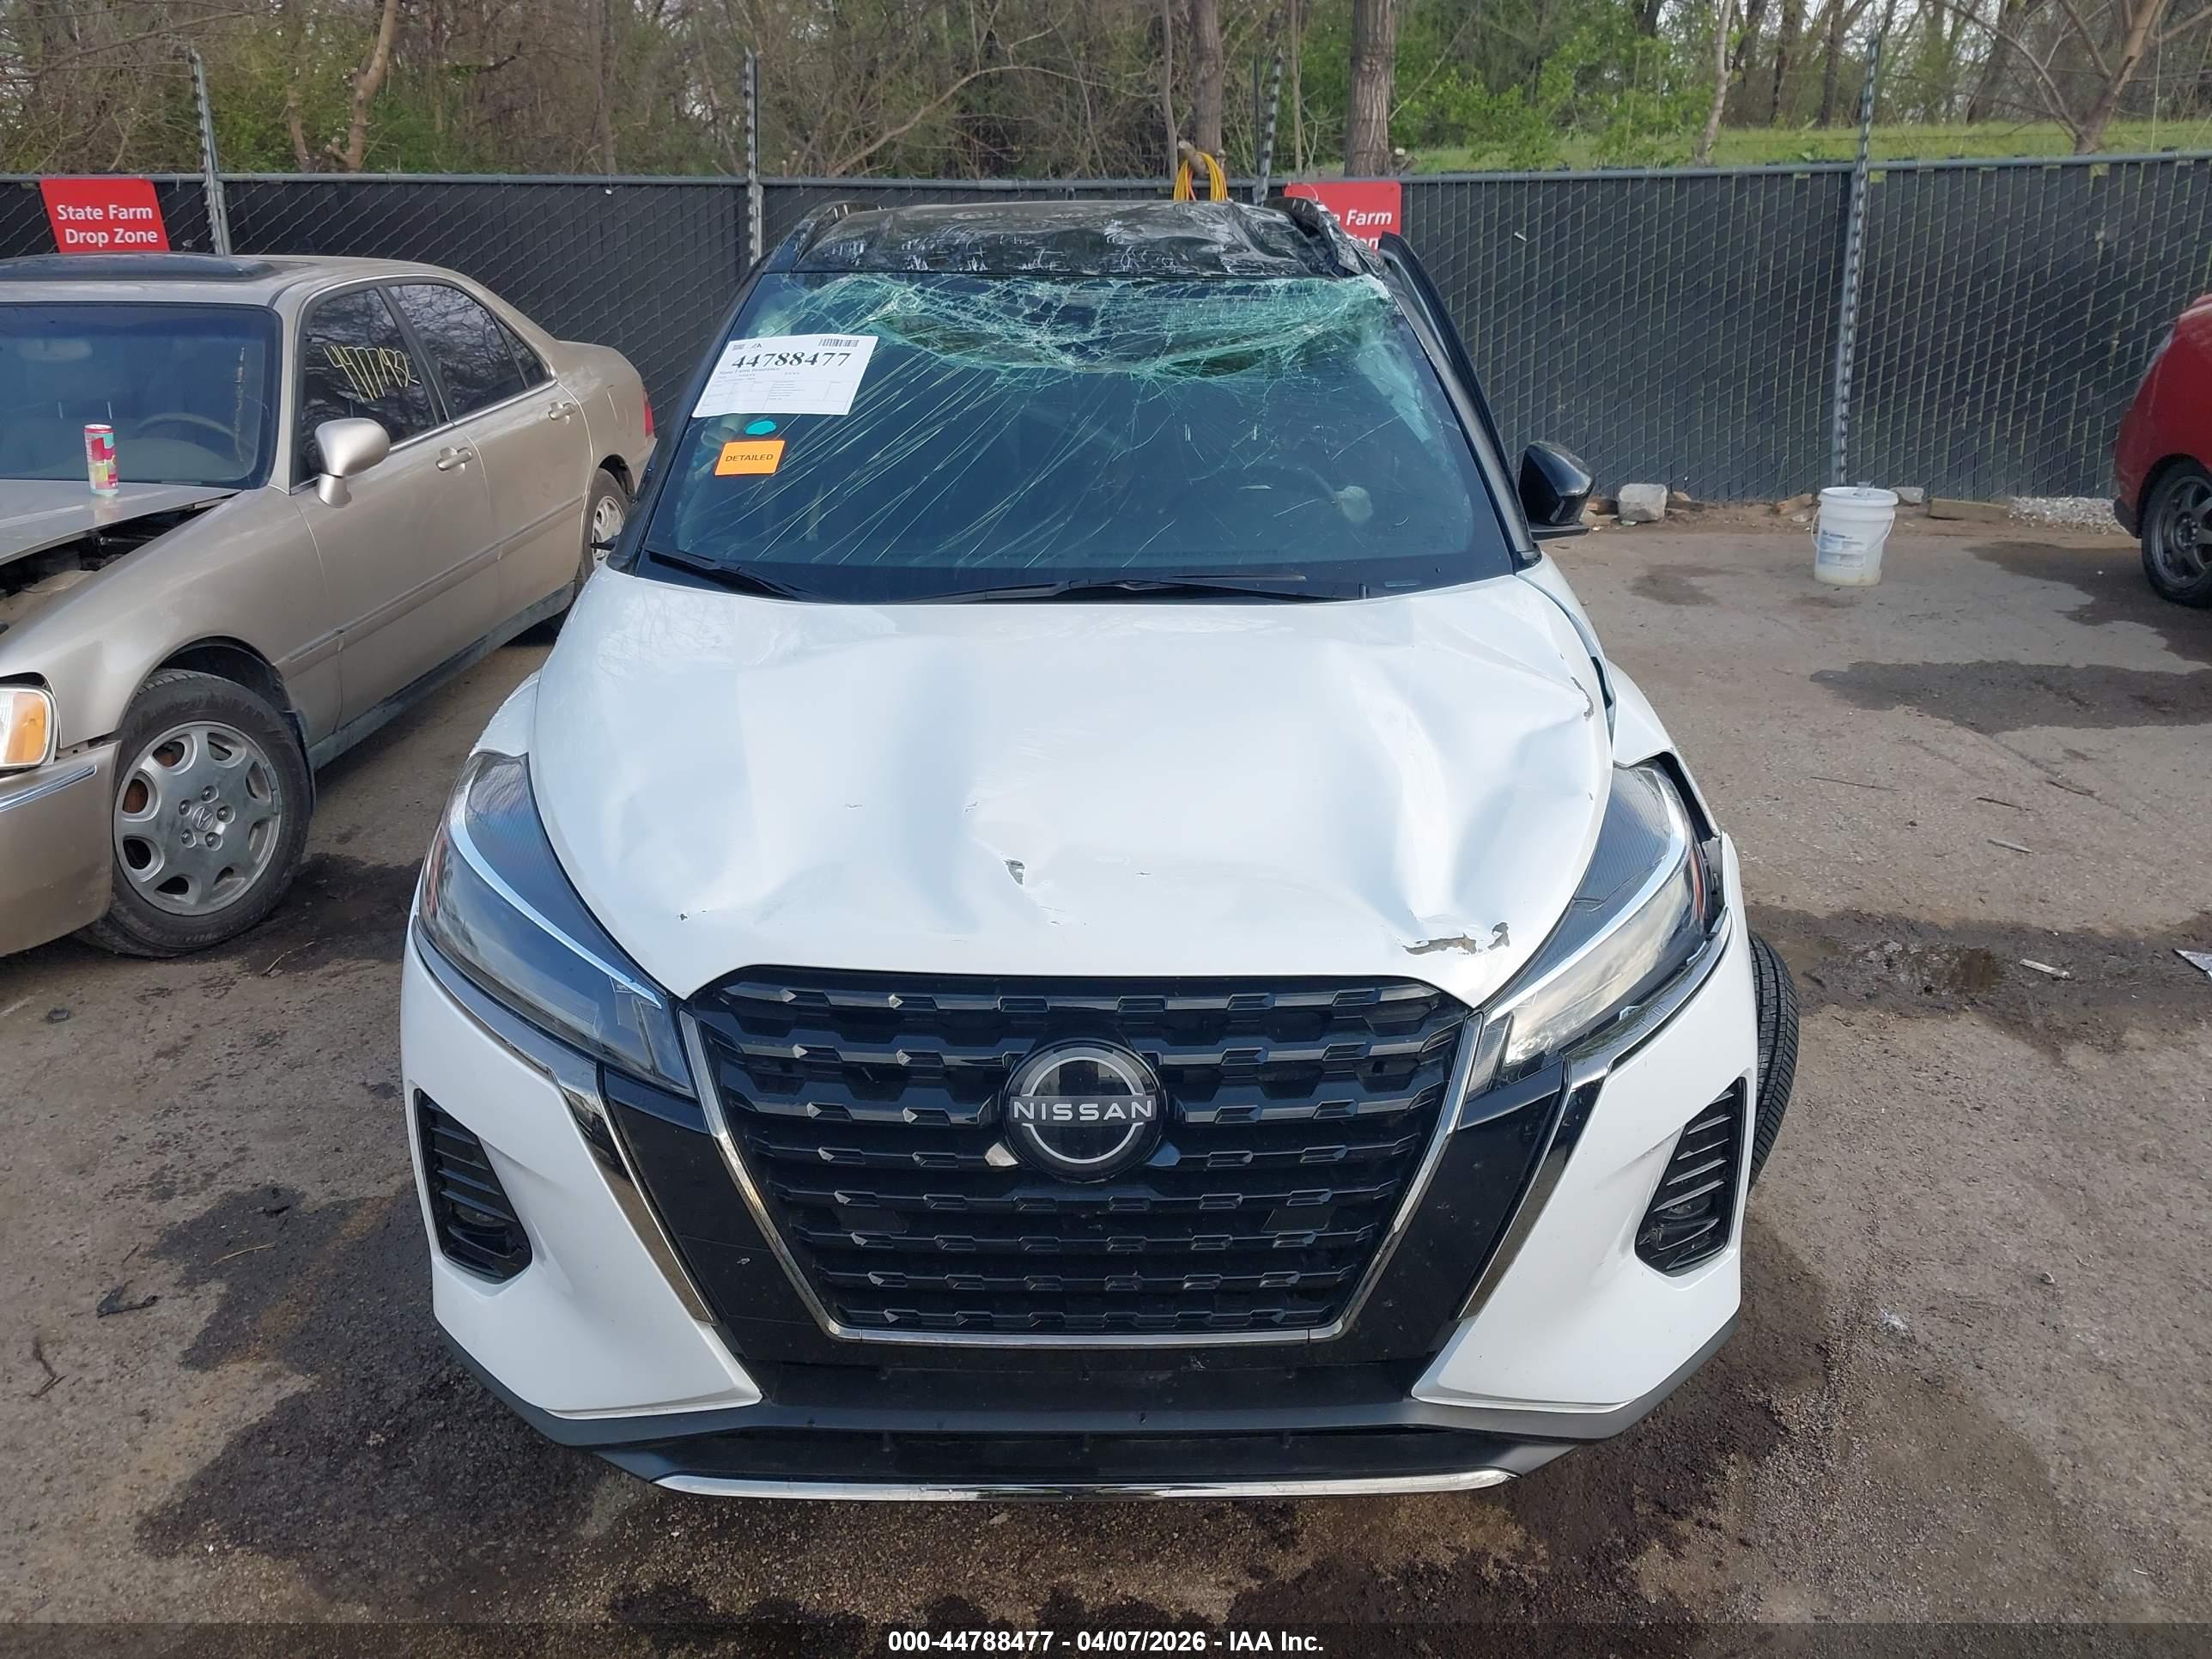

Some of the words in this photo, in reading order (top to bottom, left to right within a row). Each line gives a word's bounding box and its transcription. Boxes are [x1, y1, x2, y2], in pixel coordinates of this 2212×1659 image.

[57, 204, 104, 220] State
[109, 204, 153, 220] Farm
[1346, 210, 1392, 226] Farm
[65, 228, 108, 247] Drop
[113, 228, 158, 244] Zone
[732, 350, 852, 369] 44788477
[725, 453, 774, 462] DETAILED
[1013, 1100, 1152, 1121] NISSAN
